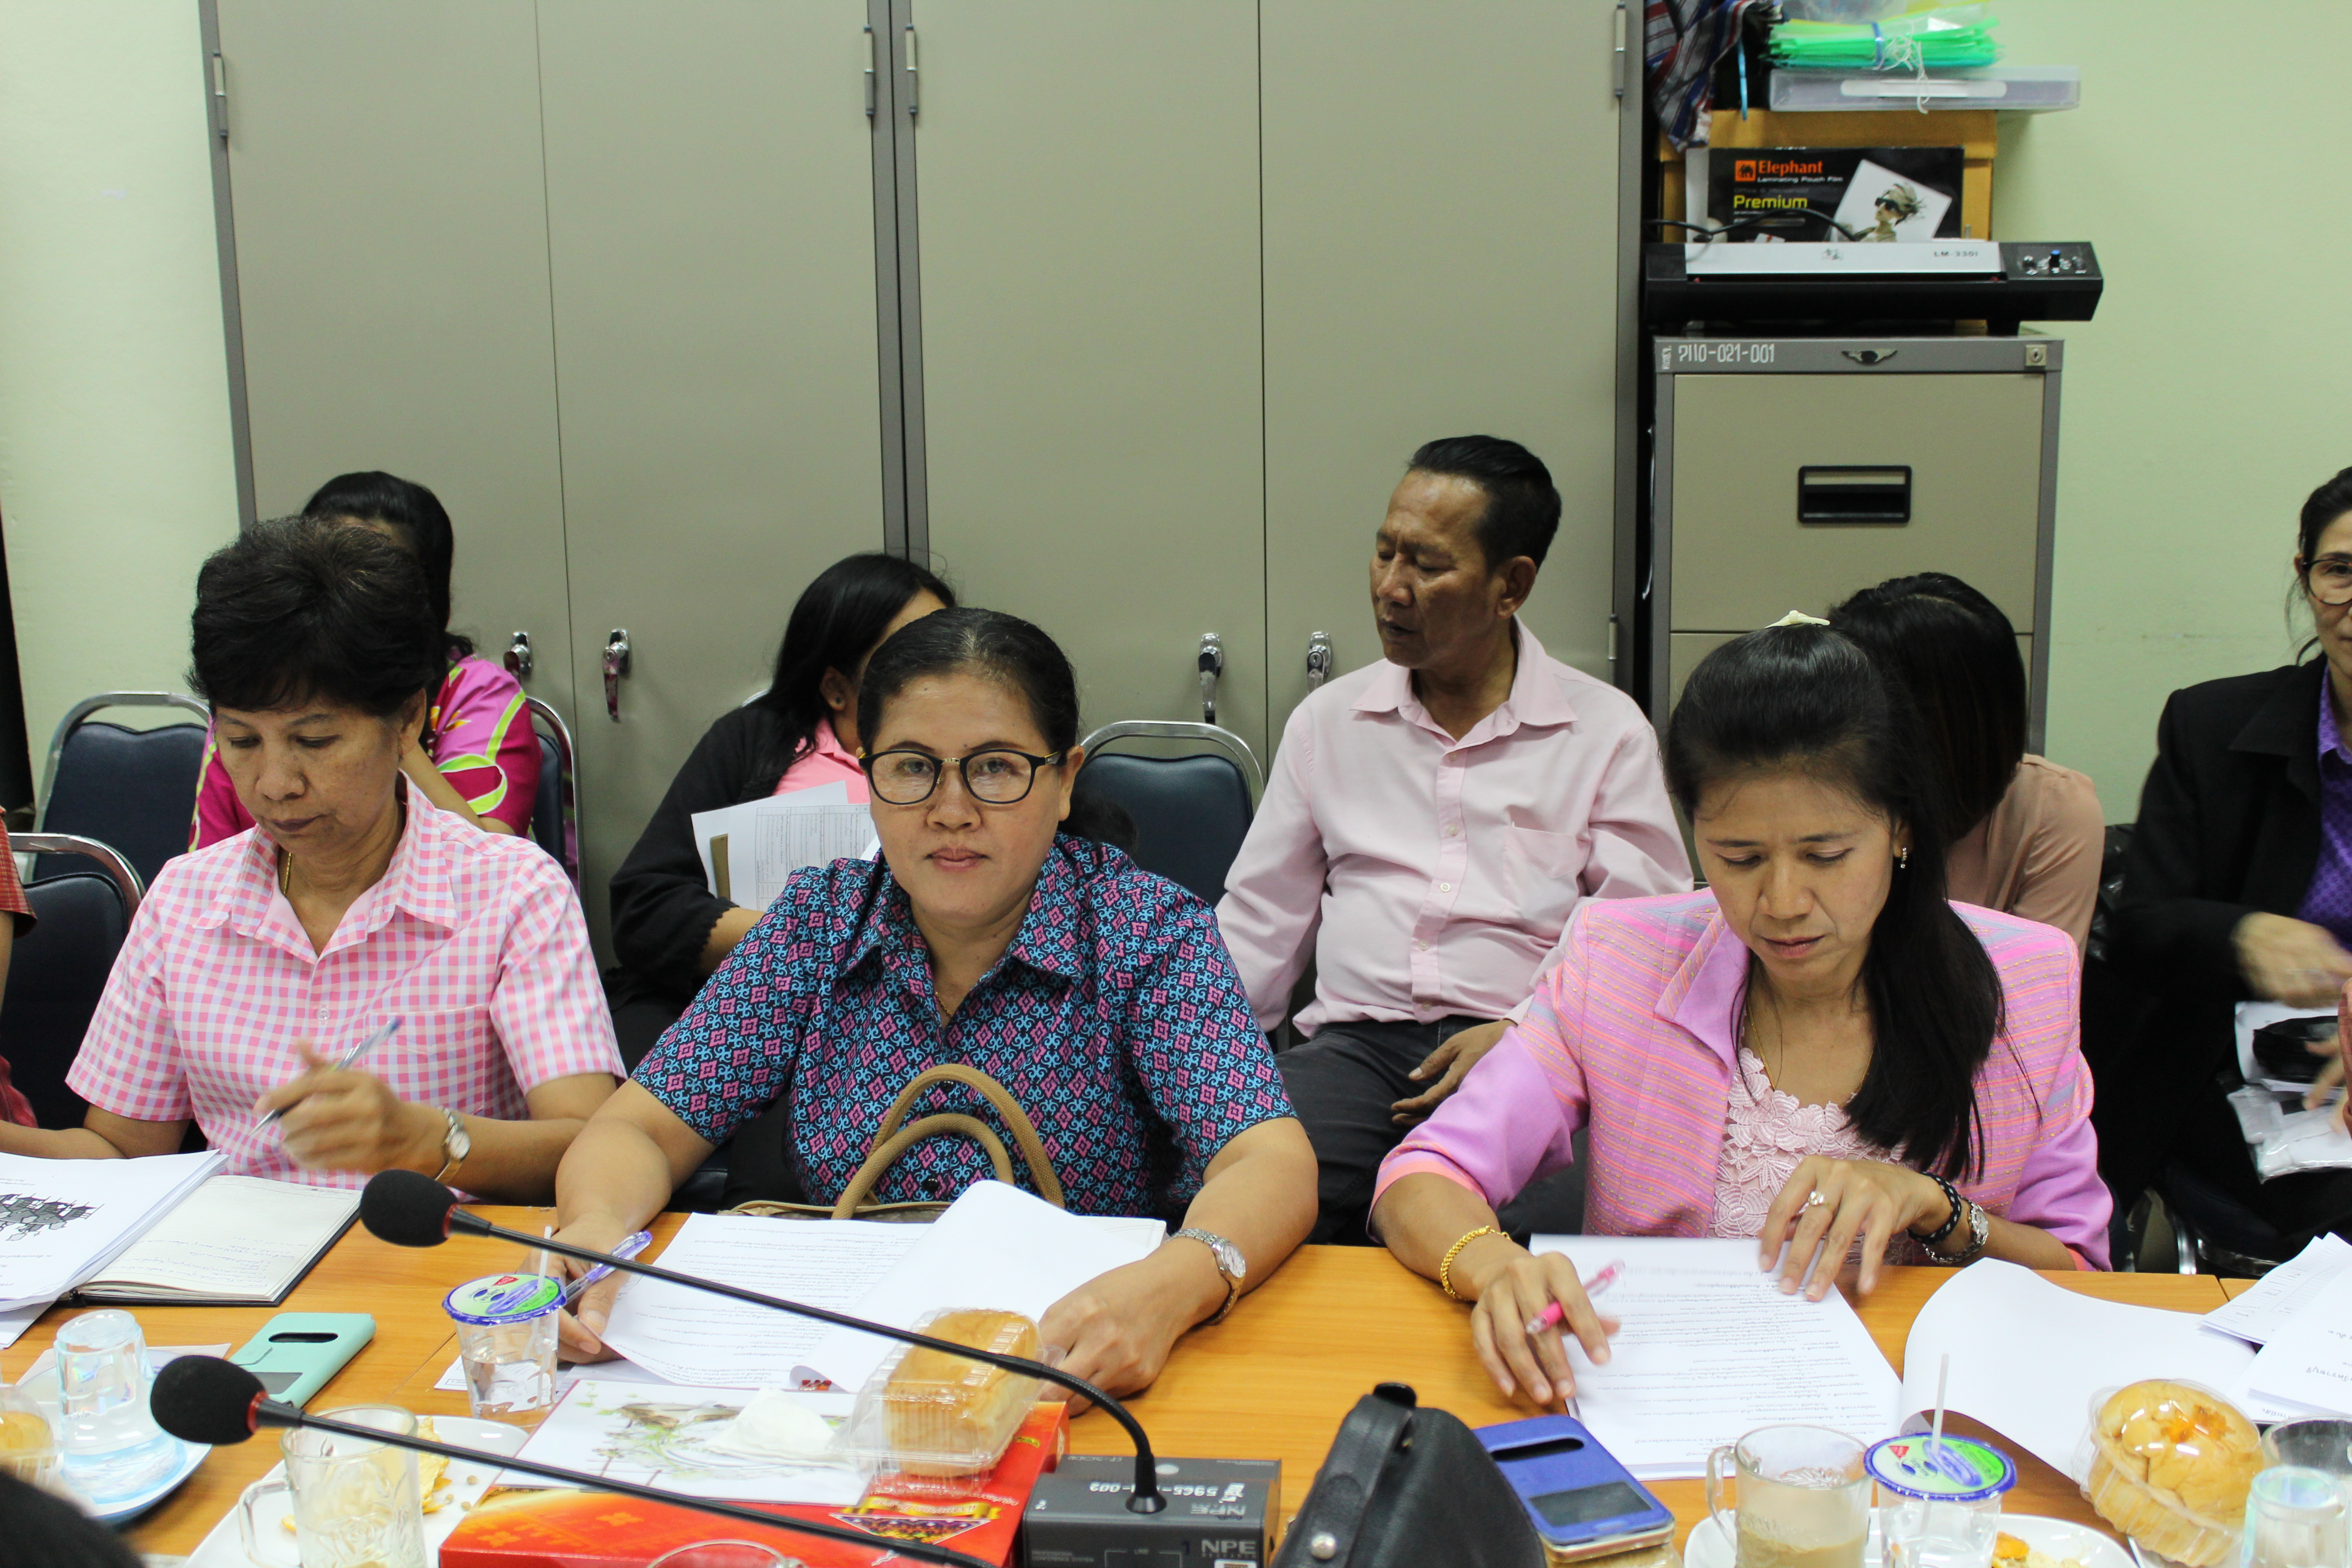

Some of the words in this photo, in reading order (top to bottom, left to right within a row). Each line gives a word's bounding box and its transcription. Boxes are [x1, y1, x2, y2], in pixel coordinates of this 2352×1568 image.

[1759, 160, 1823, 176] Elephant
[1733, 195, 1808, 208] Premium
[1190, 1506, 1246, 1516] NPE
[1201, 1539, 1256, 1554] NPE
